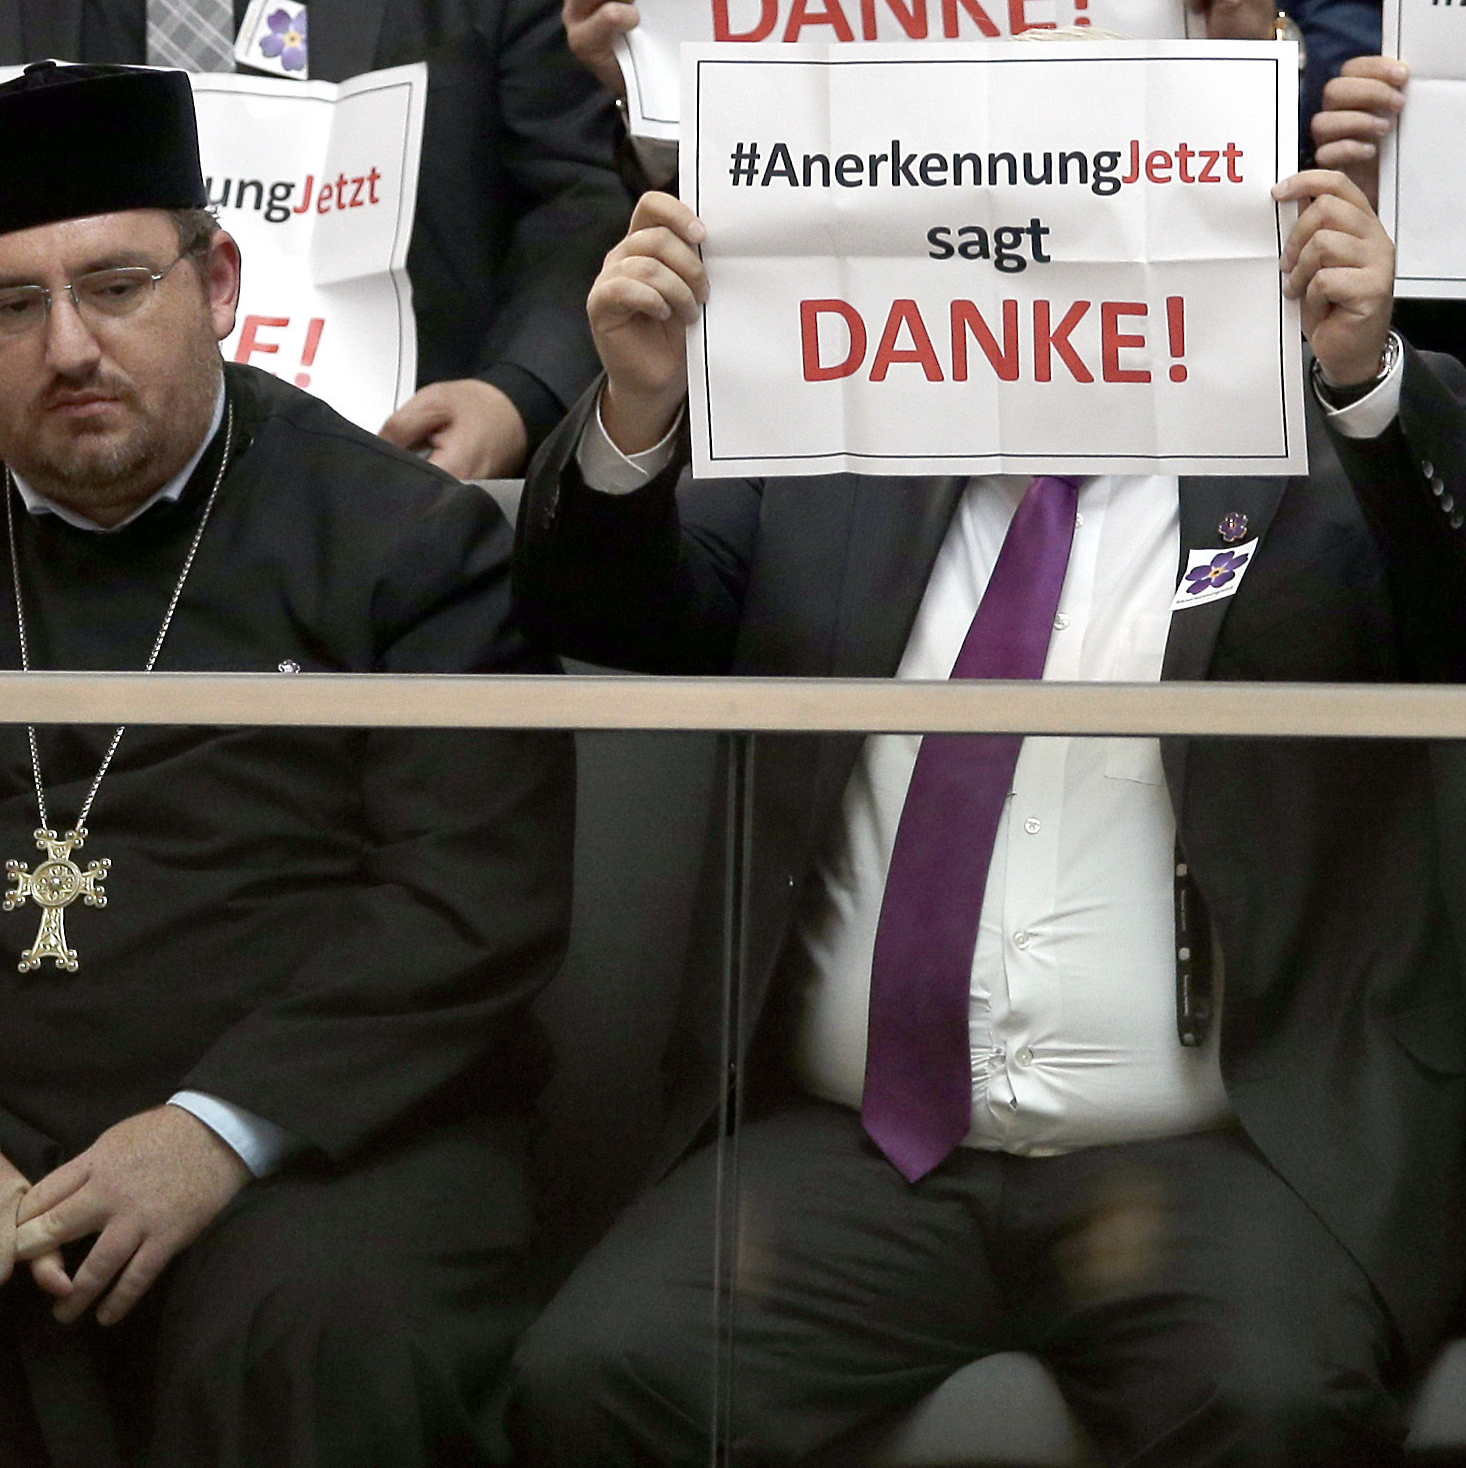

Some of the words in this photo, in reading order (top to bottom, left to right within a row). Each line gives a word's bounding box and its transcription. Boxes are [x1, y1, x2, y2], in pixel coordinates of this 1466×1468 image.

[729, 139, 1243, 196] #AnerkennungJetzt
[927, 217, 1052, 274] sagt
[800, 295, 1187, 385] DANKE!
